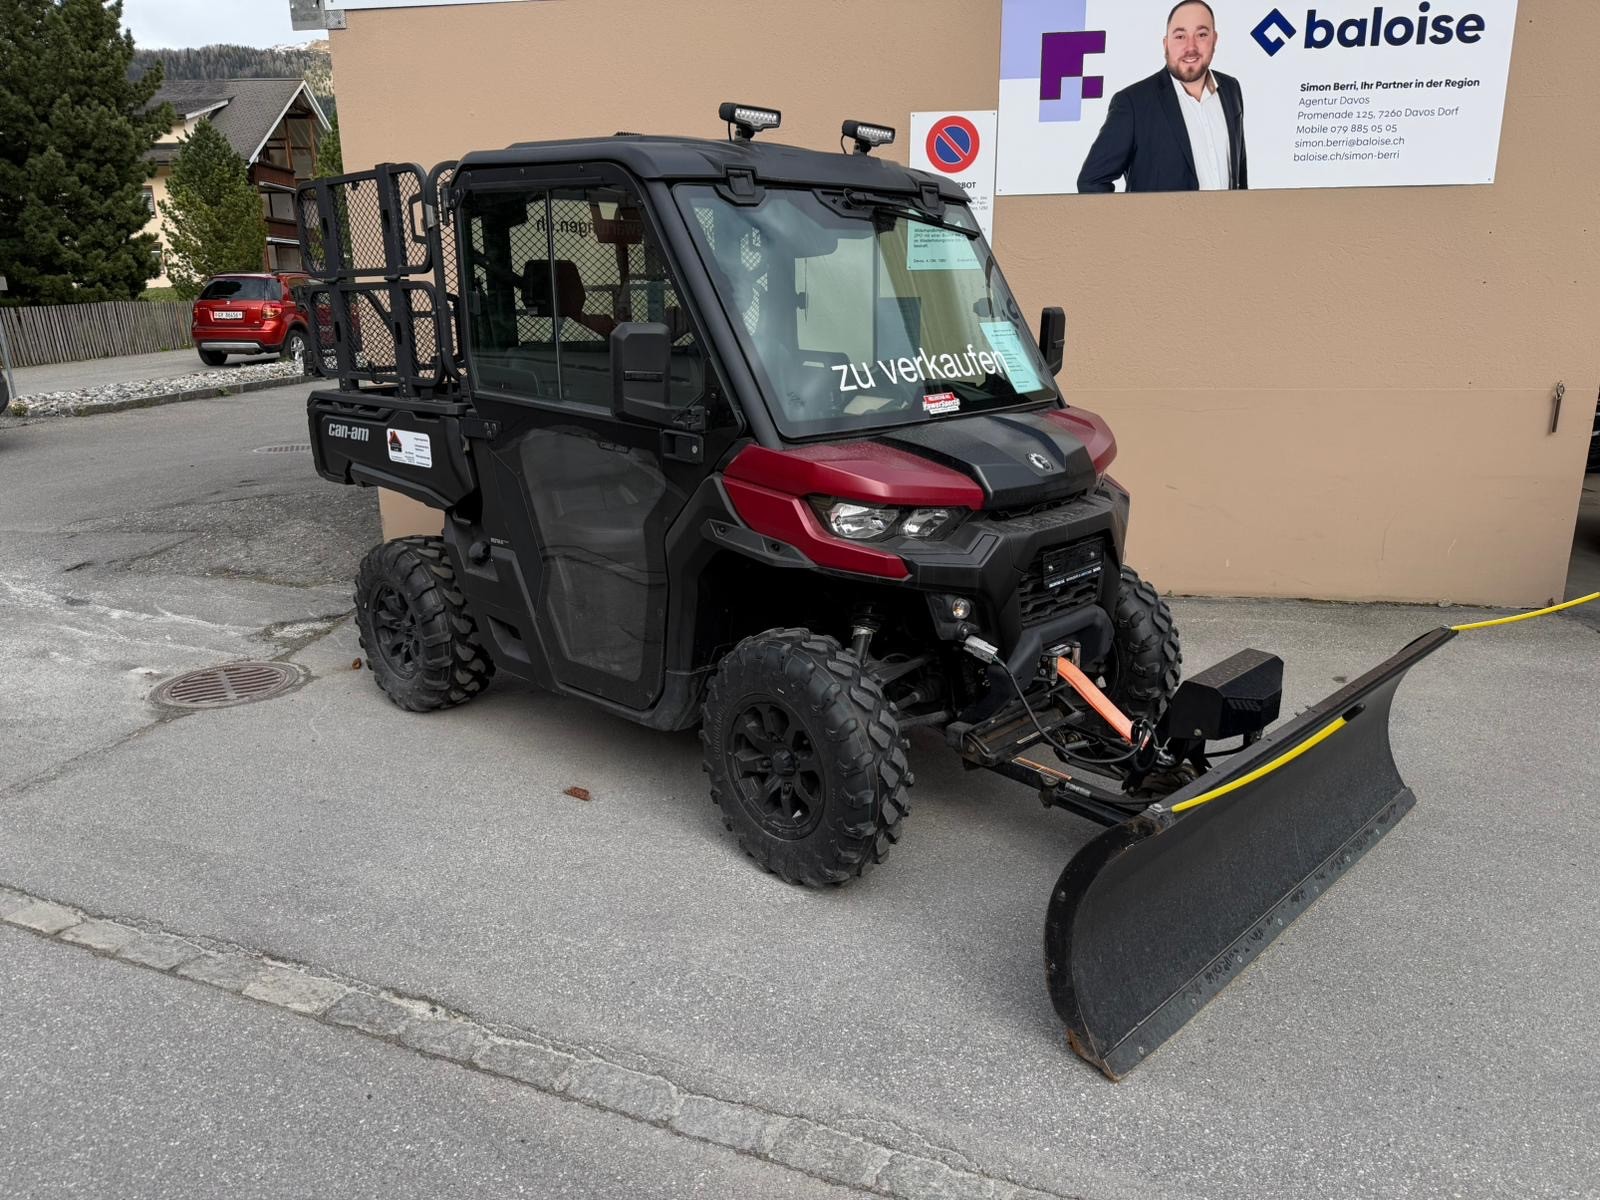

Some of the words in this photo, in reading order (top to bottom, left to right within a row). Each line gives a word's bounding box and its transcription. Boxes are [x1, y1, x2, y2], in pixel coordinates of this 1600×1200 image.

[1304, 1, 1485, 49] baloise
[1300, 83, 1331, 92] Simon
[1333, 82, 1358, 92] Berri,
[1360, 81, 1373, 91] Ihr
[1375, 80, 1412, 90] Partner
[1414, 79, 1423, 89] in
[1426, 79, 1442, 88] der
[1445, 78, 1480, 90] Region
[1299, 97, 1337, 108] Agentur
[1339, 96, 1370, 106] Davos
[1297, 110, 1353, 120] Promenade
[1356, 110, 1376, 120] 125,
[1378, 109, 1402, 119] 7260
[1404, 108, 1435, 118] Davos
[1437, 106, 1460, 117] Dorf
[1296, 124, 1328, 134] Mobile
[1330, 124, 1348, 134] 079
[1351, 123, 1368, 134] 885
[1371, 124, 1383, 134] 05
[1385, 123, 1397, 133] 05
[1294, 136, 1405, 148] simon.berri@baloise.ch
[1293, 150, 1400, 162] baloise.ch/simon-berri
[831, 361, 876, 392] zu
[877, 343, 1011, 385] verkaufen
[328, 423, 370, 442] can-am
